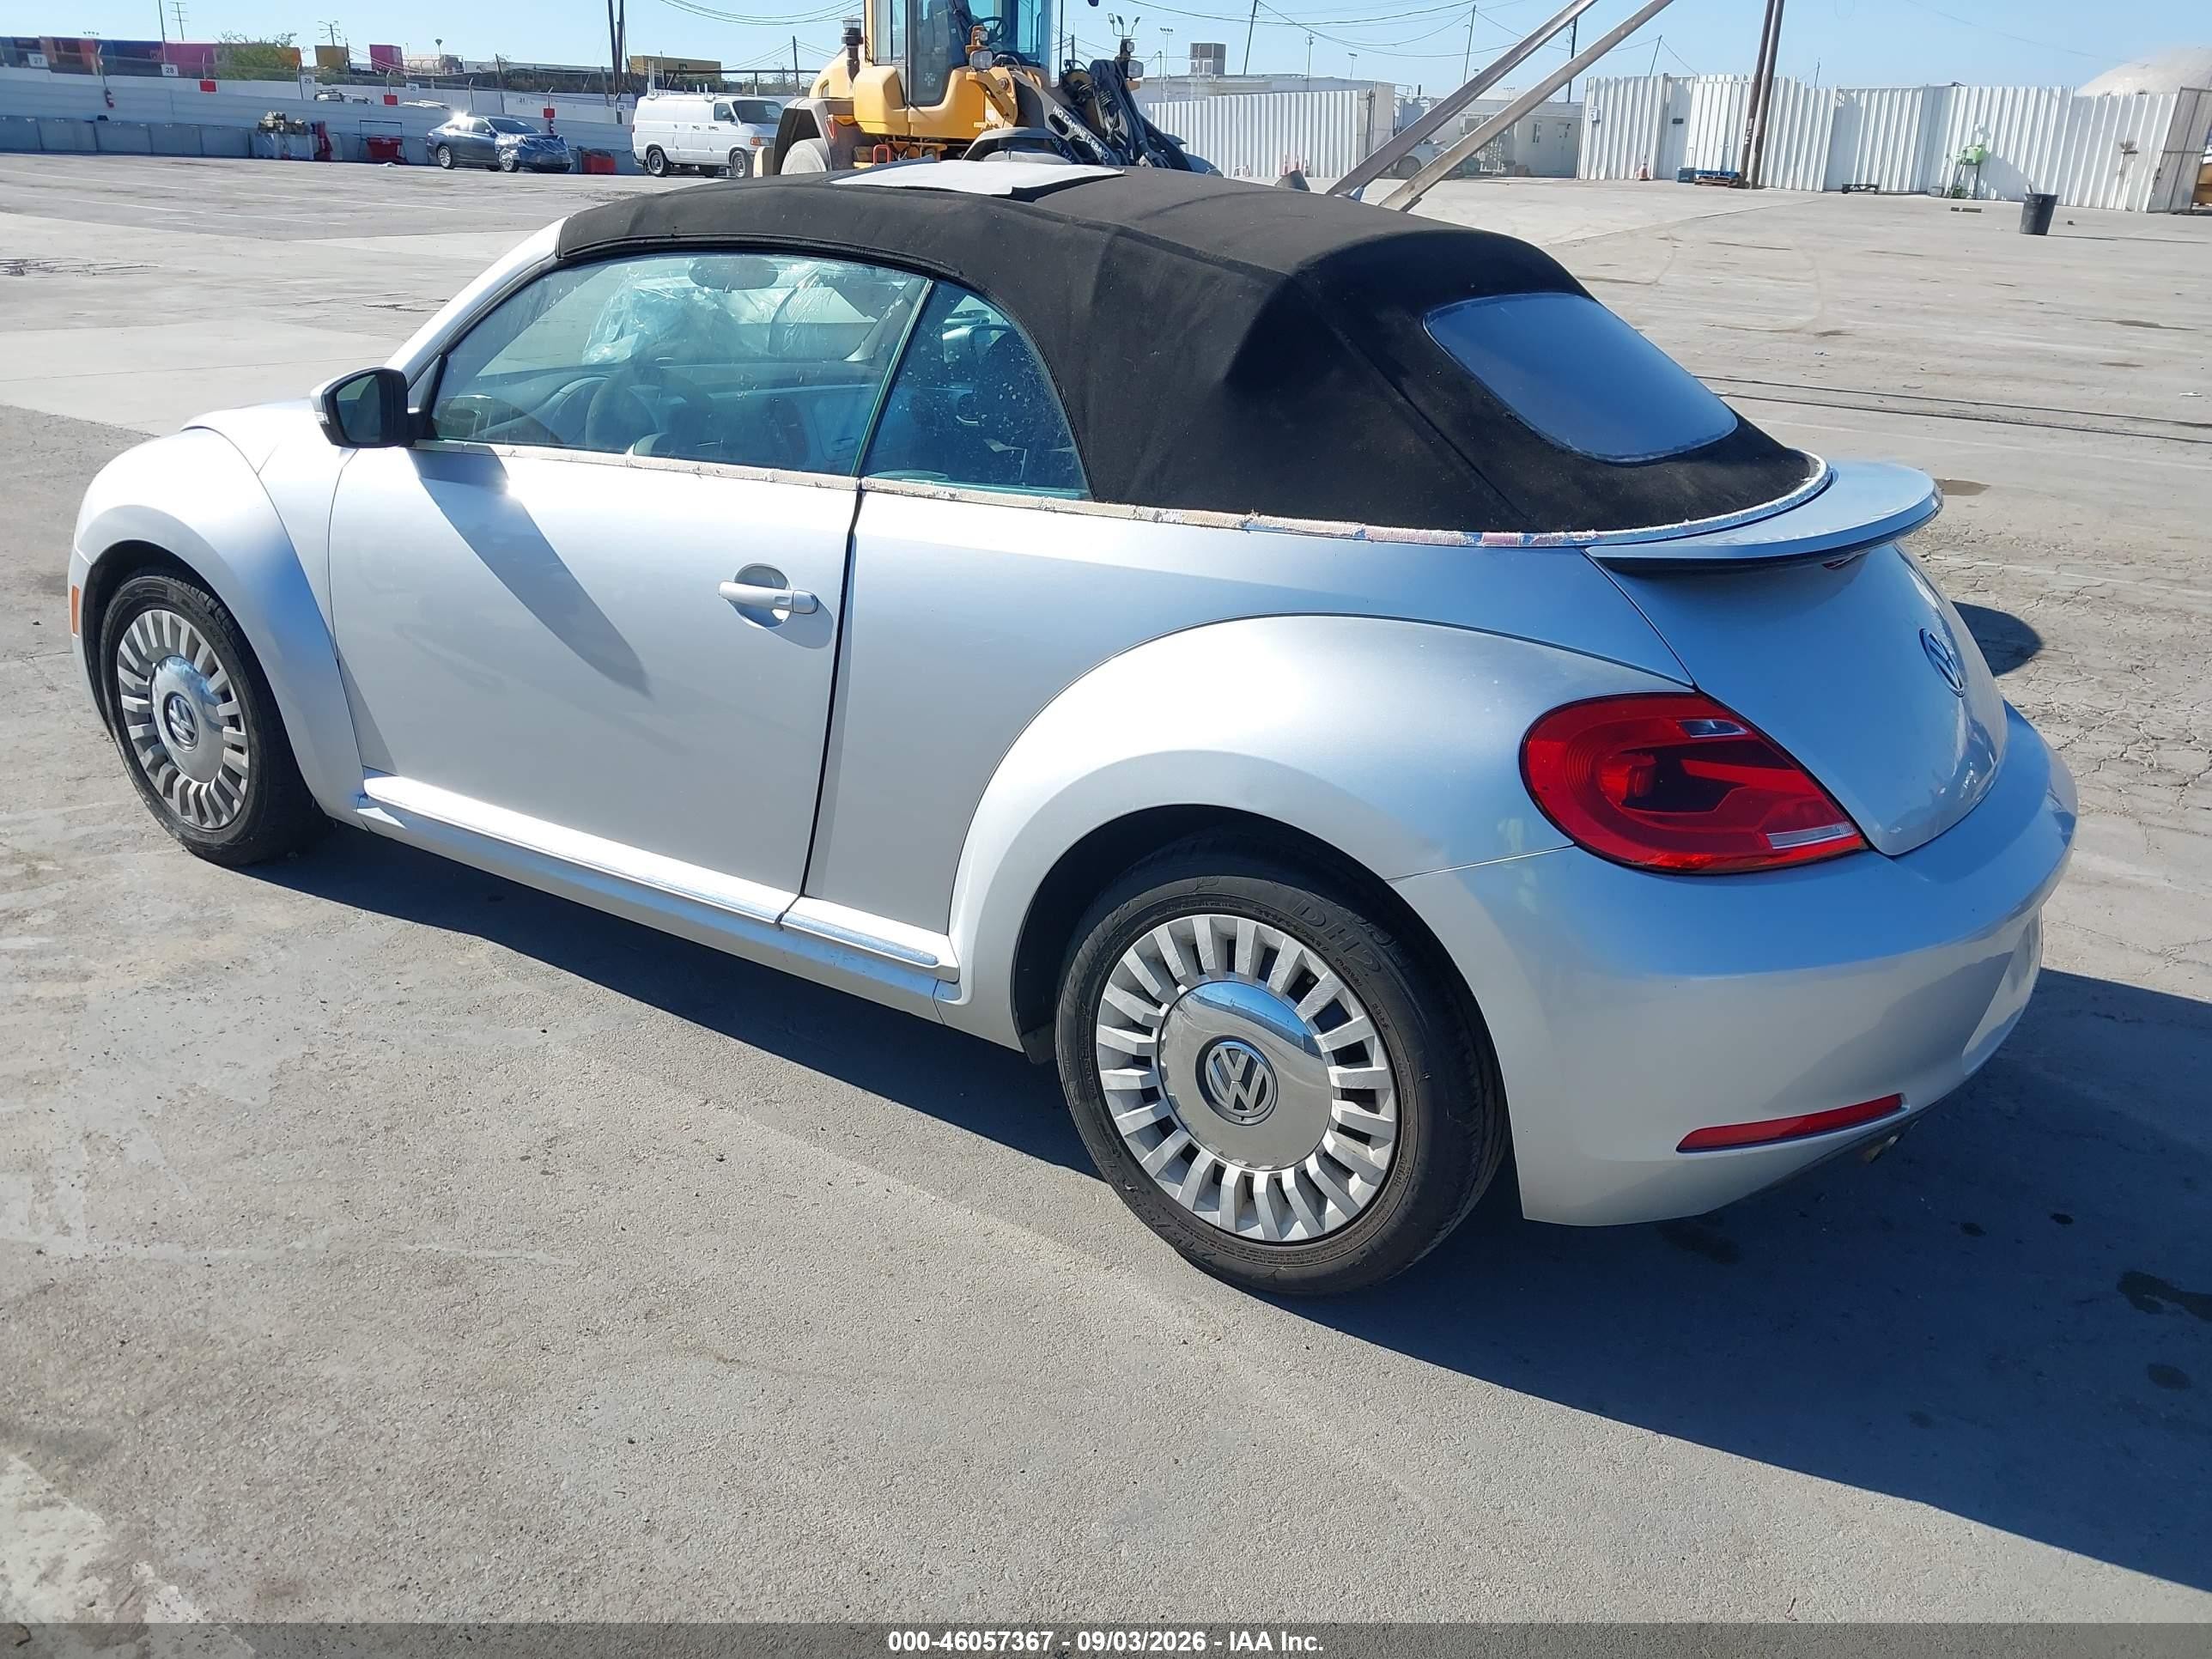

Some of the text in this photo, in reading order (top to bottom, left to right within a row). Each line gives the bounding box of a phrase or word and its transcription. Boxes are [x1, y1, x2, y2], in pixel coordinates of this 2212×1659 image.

[1052, 105, 1109, 160] NO CAMINE DEBAJO
[1052, 137, 1063, 152] DEL
